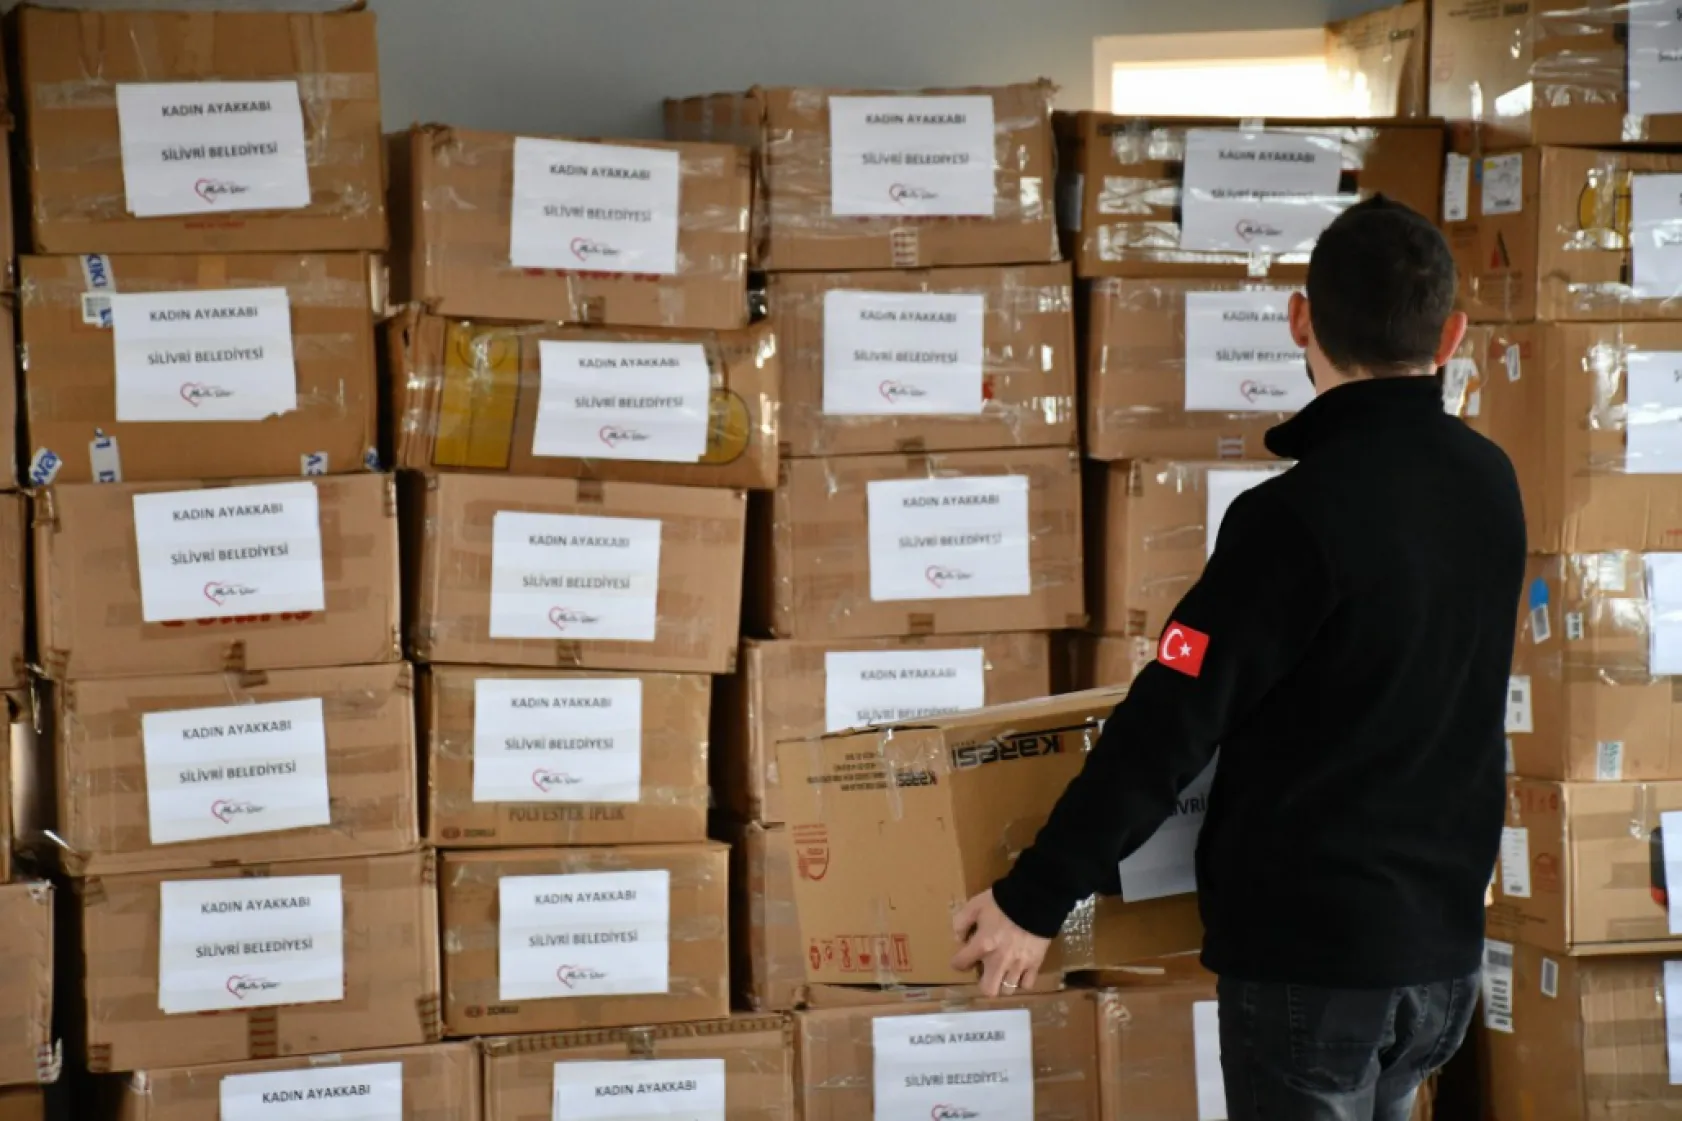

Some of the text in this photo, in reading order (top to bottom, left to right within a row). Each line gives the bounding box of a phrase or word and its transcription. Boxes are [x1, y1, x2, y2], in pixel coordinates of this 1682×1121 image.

[161, 100, 272, 117] KADIN AYAKKABI
[864, 113, 967, 125] KADIN AYAKKABI
[161, 141, 279, 162] SİLİVRİ BELEDİYESİ
[1218, 149, 1316, 164] KADIN AYAKKABI
[548, 164, 651, 181] KADIN AYAKKABI
[543, 204, 652, 223] SİLİVRİ BELEDİYESİ
[149, 306, 259, 322] KADIN AYAKKABI
[859, 310, 957, 324] KADIN AYAKKABI
[1222, 310, 1260, 323] KADIN
[147, 346, 264, 366] SİLİVRİ BELEDİYESİ
[578, 357, 681, 369] KADIN AYAKKABI
[902, 494, 1000, 508] KADIN AYAKKABI
[172, 502, 284, 522] KADIN AYAKKABI
[528, 534, 630, 548] KADIN AYAKKABI
[170, 542, 289, 566] SİLİVRİ BELEDİYESİ
[522, 575, 631, 590] SİLİVRİ BELEDİYESİ
[859, 668, 957, 681] KADIN AYAKKABI
[510, 697, 612, 709] KADIN AYAKKABI
[182, 719, 292, 740] KADIN AYAKKABI
[504, 737, 614, 751] SİLİVRİ BELEDİYESİ
[179, 759, 297, 785] SİLİVRİ BELEDİYESİ
[534, 889, 637, 905] KADIN AYAKKABI
[200, 896, 312, 915] KADIN AYAKKABI
[528, 929, 639, 948] SİLİVRİ BELEDİYESİ
[195, 937, 313, 959] SİLİVRİ BELEDİYESİ
[908, 1030, 1006, 1046] KADIN AYAKKABI
[594, 1079, 697, 1097] KADIN AYAKKABI
[904, 1072, 945, 1088] SİLİVRİ
[261, 1084, 371, 1104] KADIN AYAKKABI
